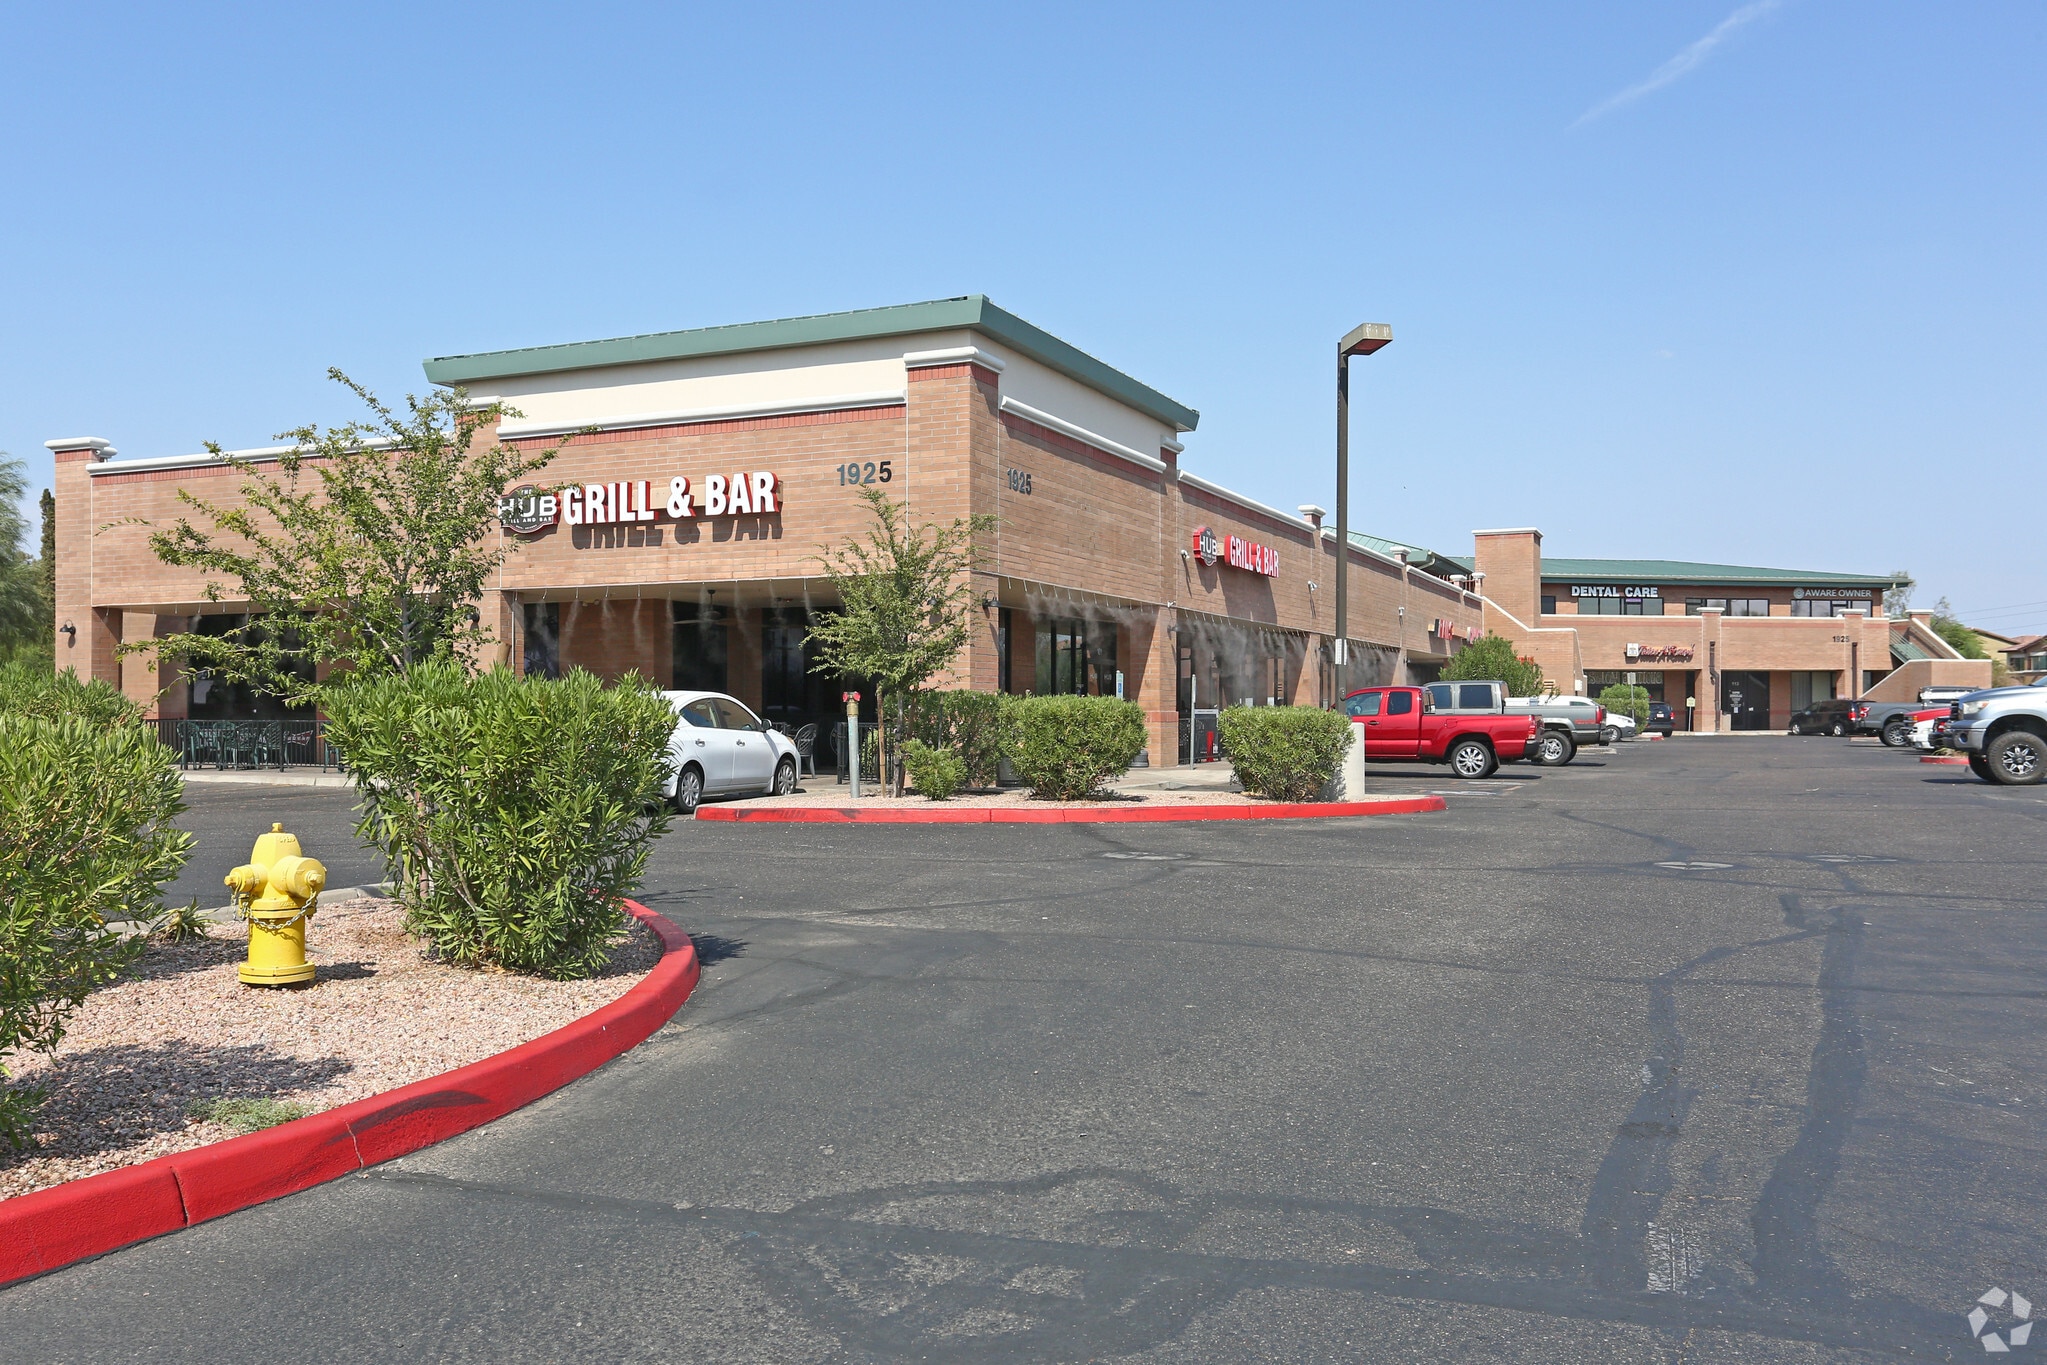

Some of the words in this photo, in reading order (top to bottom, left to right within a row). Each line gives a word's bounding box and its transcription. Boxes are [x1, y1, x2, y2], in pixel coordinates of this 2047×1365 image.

[836, 460, 892, 486] 1925
[1007, 467, 1032, 496] 1925
[497, 495, 558, 519] HUB
[563, 480, 657, 526] GRILL
[666, 475, 693, 518] &
[705, 471, 778, 516] BAR
[1199, 535, 1218, 556] HUB
[1230, 535, 1254, 572] GRILL
[1256, 543, 1262, 573] &
[1263, 546, 1279, 578] BAR
[1571, 585, 1620, 597] DENTAL
[1624, 586, 1659, 598] CARE
[1805, 589, 1837, 597] AWARE
[1838, 589, 1872, 597] OWNER
[1832, 635, 1850, 643] 1925
